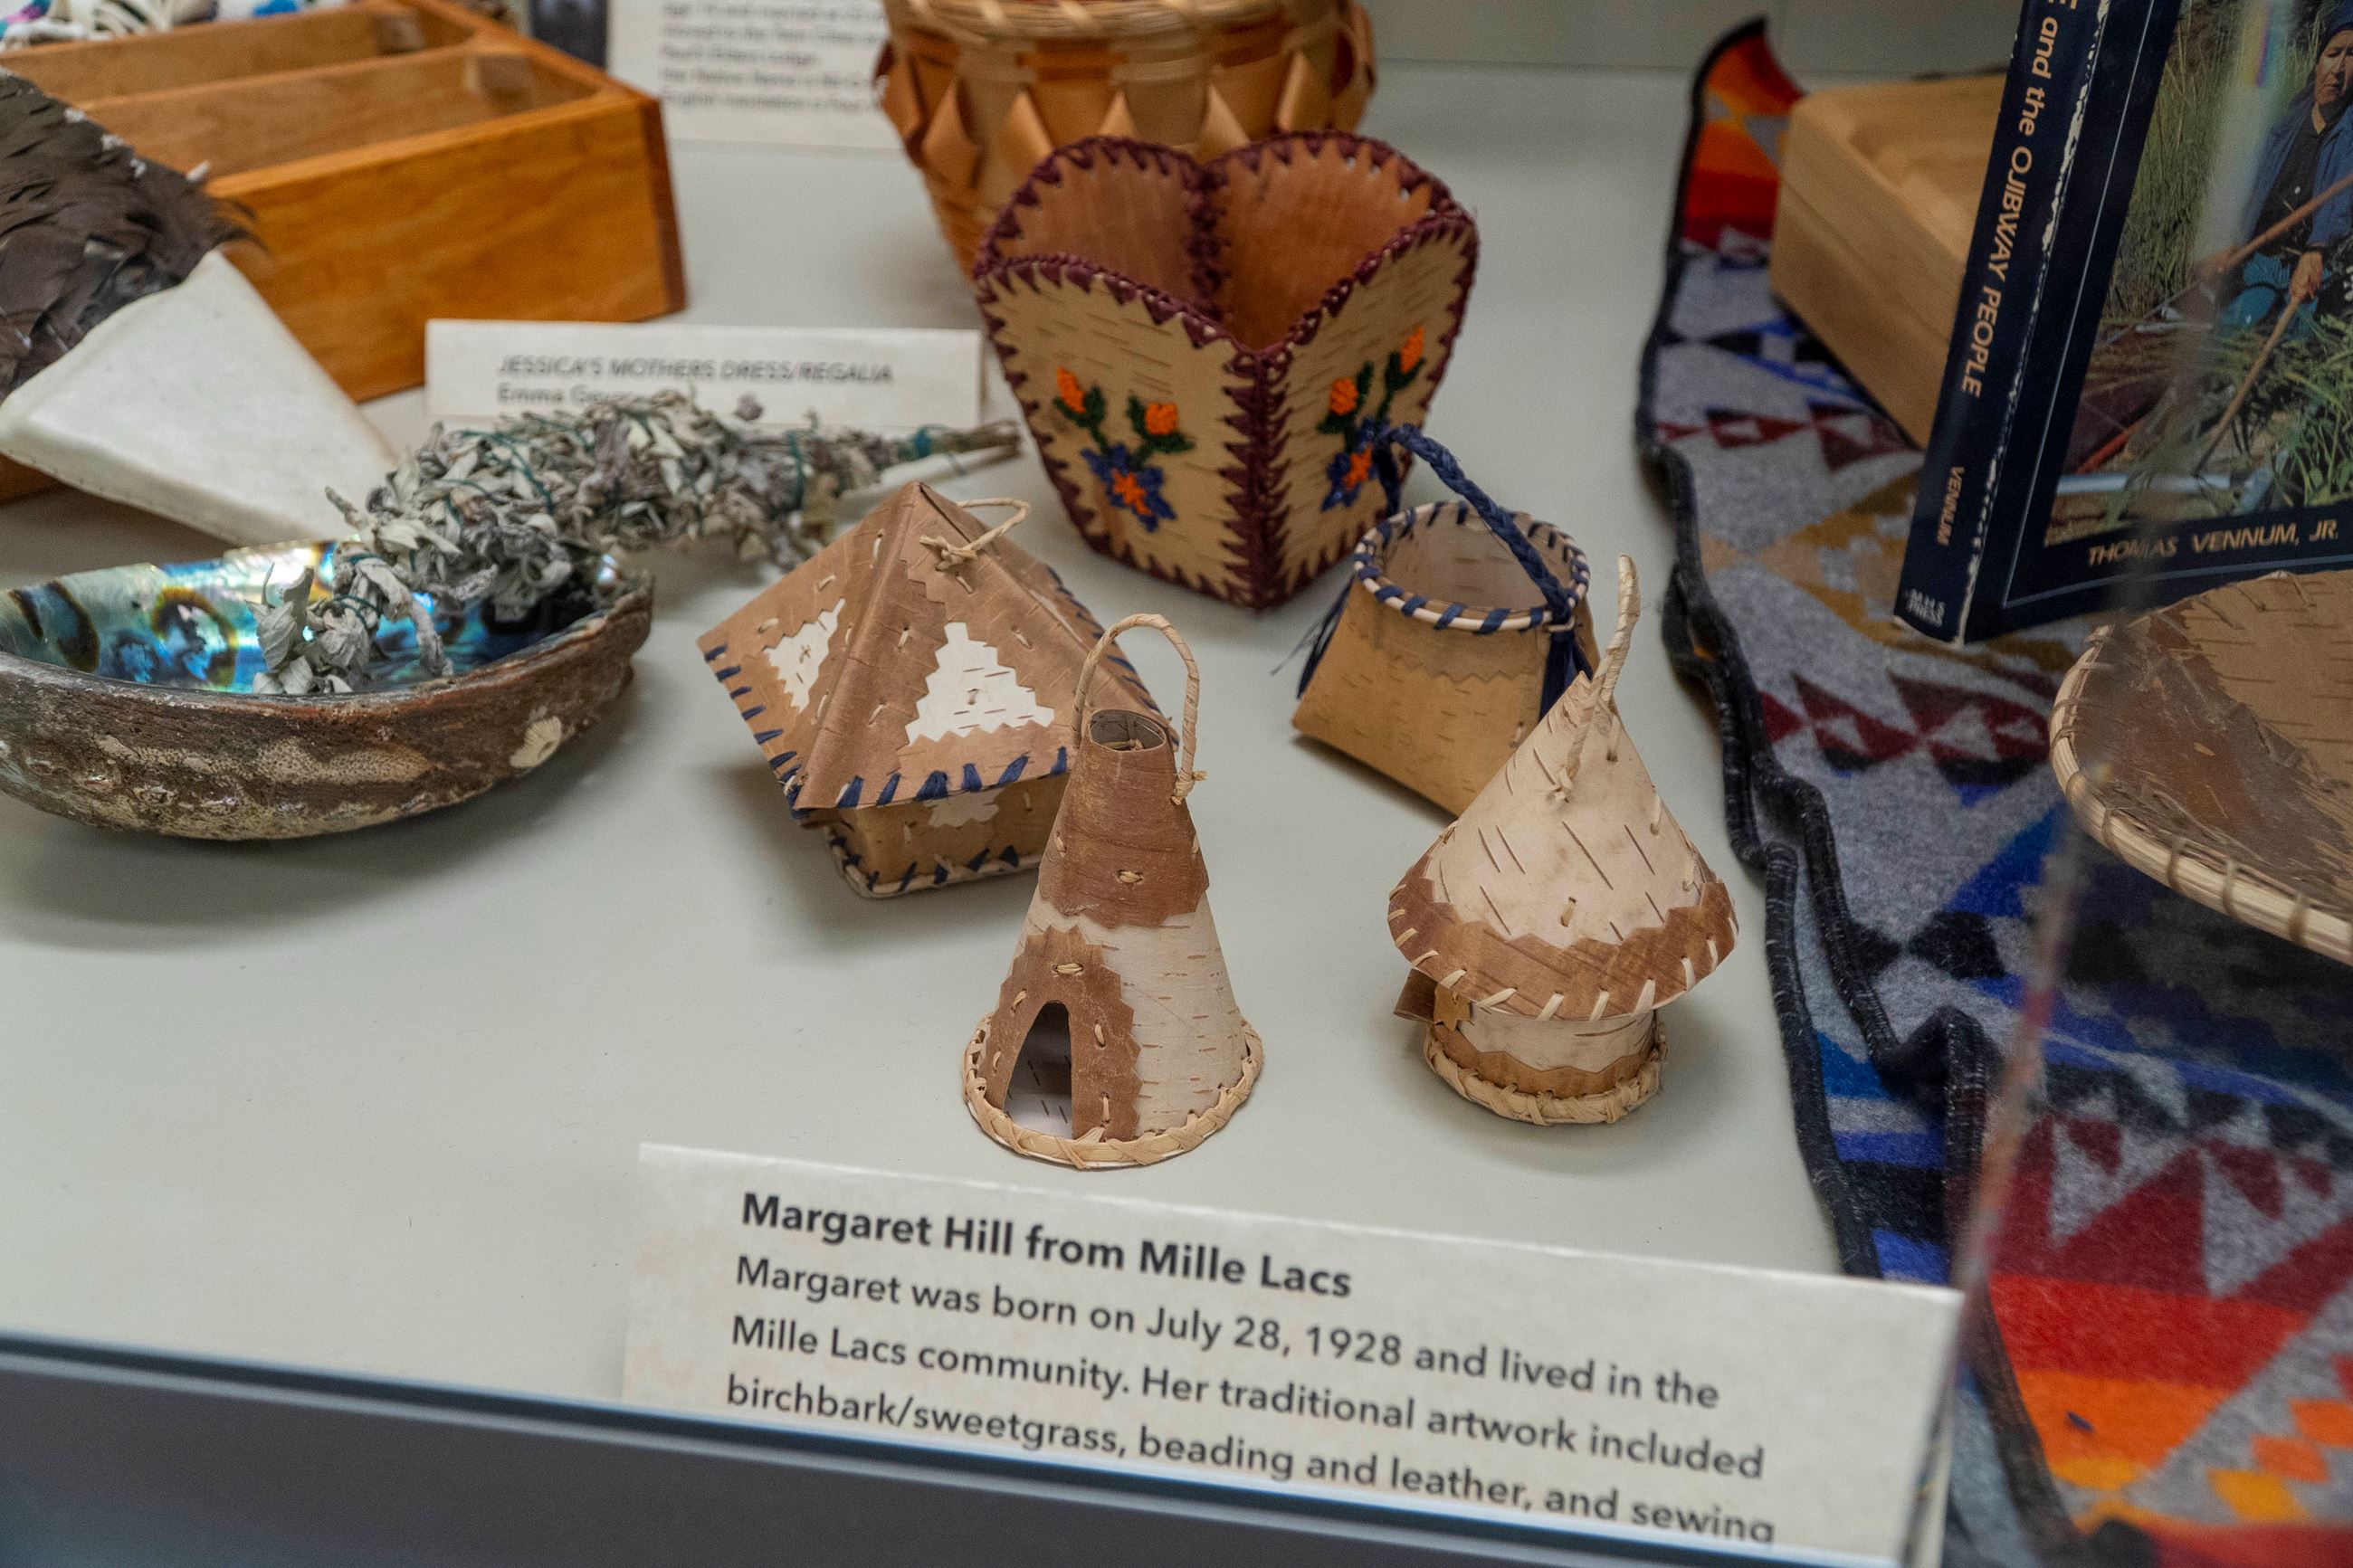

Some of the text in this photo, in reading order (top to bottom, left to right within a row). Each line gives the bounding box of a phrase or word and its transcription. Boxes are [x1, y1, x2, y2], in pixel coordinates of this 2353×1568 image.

[1960, 16, 2058, 398] and the OJIBWAY PEOPLE
[498, 383, 564, 404] Emma
[1936, 466, 1965, 546] VENNUM
[2089, 536, 2178, 566] THOMAS
[741, 1193, 1352, 1297] Margaret Hill from Mille Lacs
[737, 1256, 1720, 1410] Margaret was born on July 28, 1928 and lived in the
[726, 1374, 1127, 1459] birchbark/sweetgrass,
[1139, 1425, 1293, 1480] beading
[1307, 1448, 1377, 1485] and
[1390, 1458, 1531, 1513] leather,
[1545, 1484, 1619, 1521] and
[731, 1316, 1764, 1480] Mille Lacs community. Her traditional artwork included
